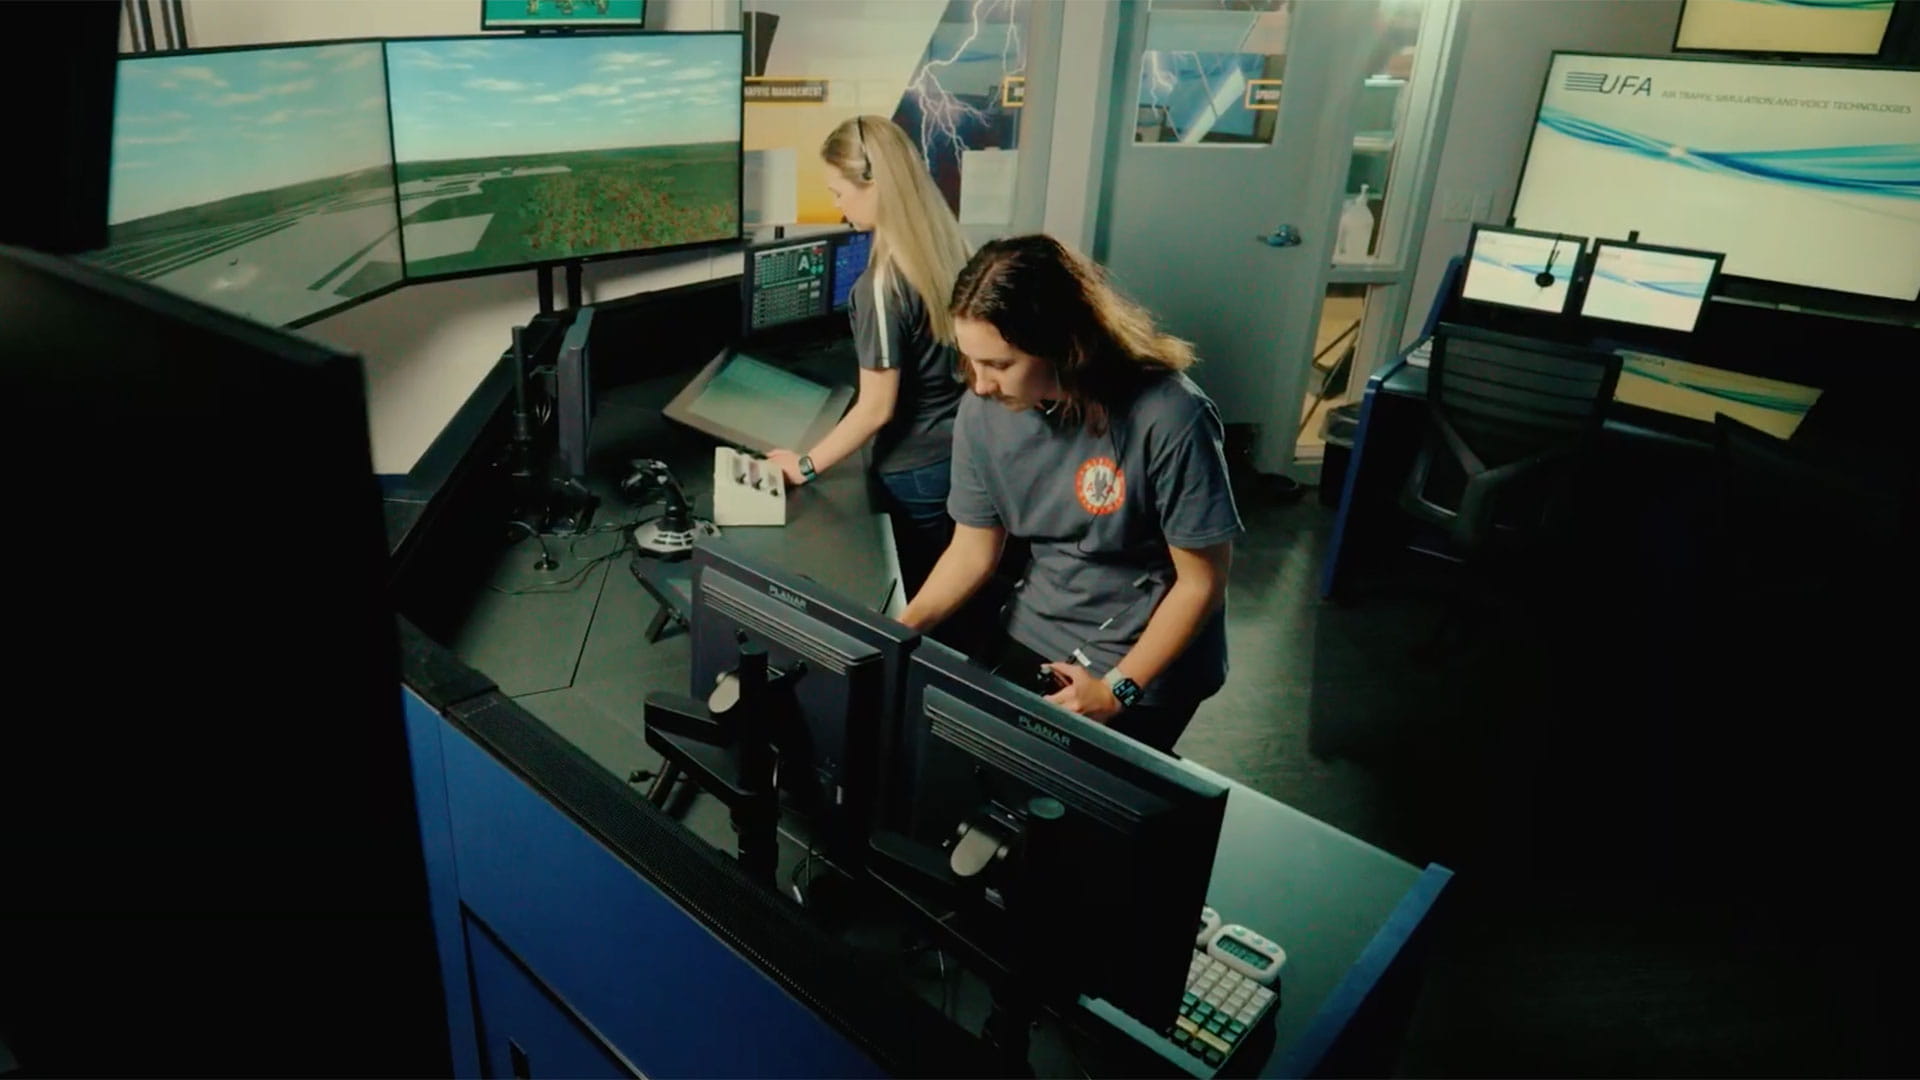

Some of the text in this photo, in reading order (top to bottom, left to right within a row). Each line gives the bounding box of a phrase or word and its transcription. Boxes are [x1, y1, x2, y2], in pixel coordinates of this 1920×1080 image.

[771, 86, 823, 98] MANAGEMENT
[1599, 73, 1653, 97] UFA
[1679, 91, 1713, 102] TRAFFIC
[1715, 94, 1773, 106] SIMULATION
[1774, 98, 1798, 108] AND
[1800, 99, 1830, 110] VOICE
[1832, 101, 1912, 115] TECHNOLOGIES
[768, 584, 807, 609] PLANAR
[1018, 714, 1071, 747] PLANAR
